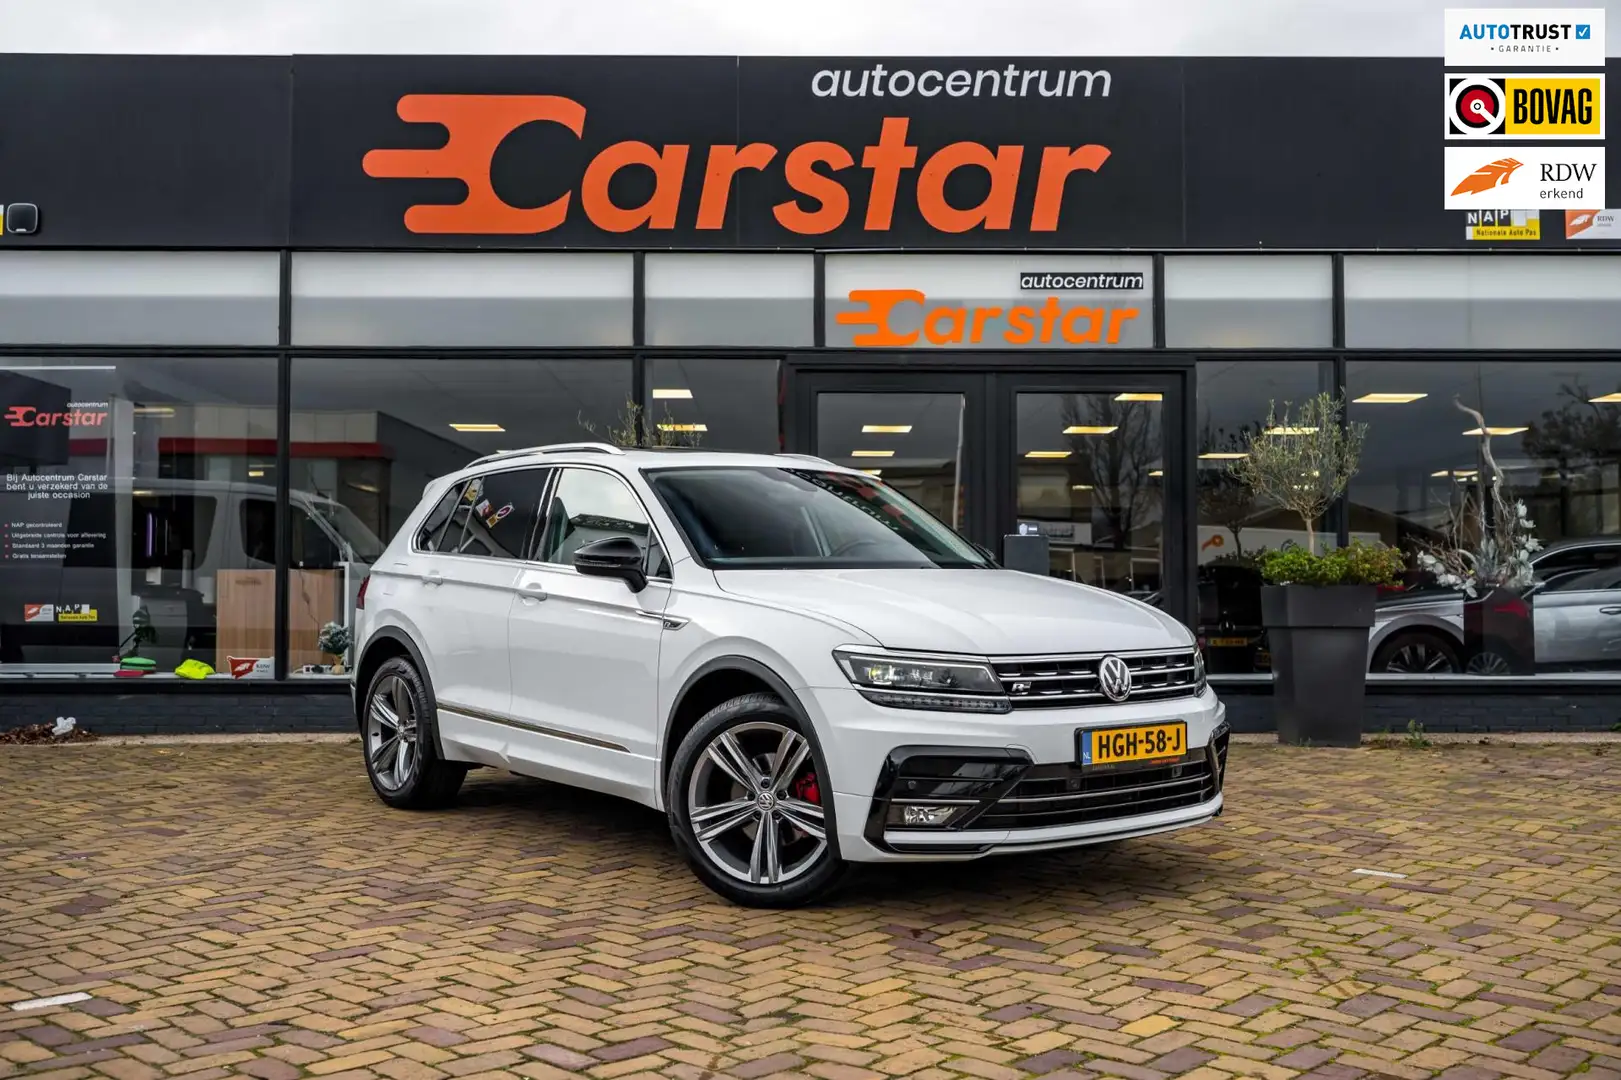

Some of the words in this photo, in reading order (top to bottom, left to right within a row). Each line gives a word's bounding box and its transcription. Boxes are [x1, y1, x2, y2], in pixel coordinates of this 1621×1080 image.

[811, 64, 1112, 97] autocentrum
[362, 94, 1112, 234] Carstar
[1509, 229, 1524, 237] Auto
[1021, 274, 1143, 288] autocentrum
[835, 289, 1140, 347] Carstar
[4, 405, 108, 427] Carstar
[6, 474, 18, 483] Bij
[21, 474, 75, 482] Autocentrum
[78, 473, 108, 482] Carstar
[6, 483, 26, 491] bent
[98, 482, 108, 490] de
[28, 491, 50, 500] juiste
[52, 491, 91, 499] occasion
[1098, 727, 1181, 759] HGH-58-J
[1083, 751, 1091, 760] NL
